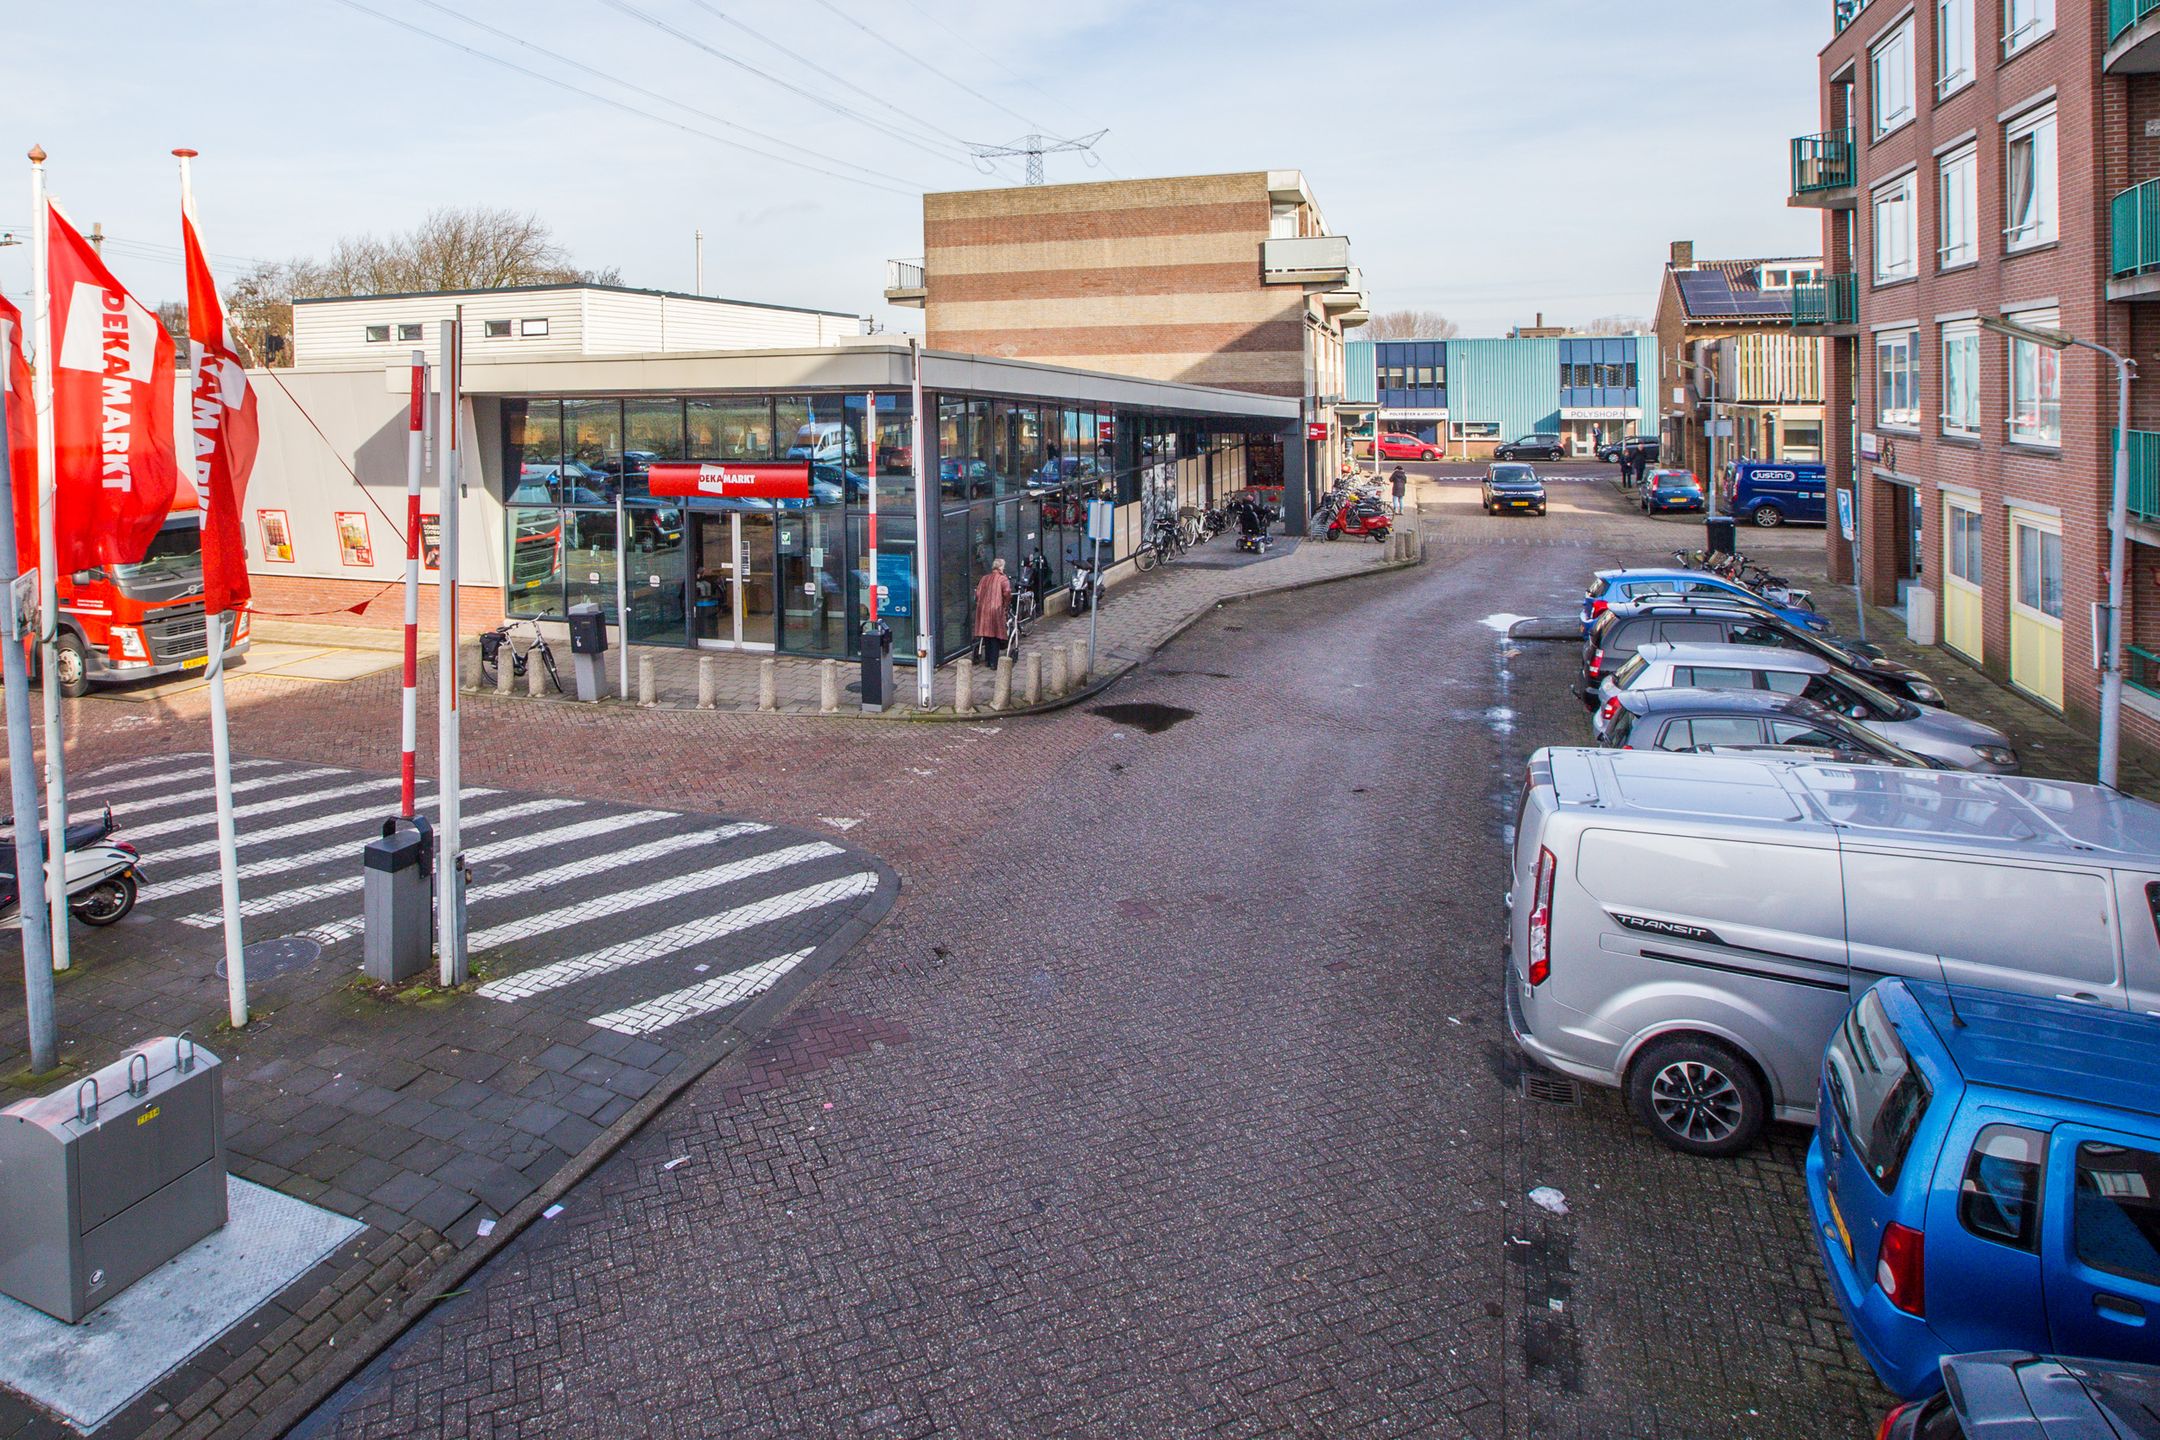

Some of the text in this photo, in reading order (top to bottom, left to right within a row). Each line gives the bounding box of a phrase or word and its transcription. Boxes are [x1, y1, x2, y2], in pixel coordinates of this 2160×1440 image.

[102, 289, 132, 493] DEKAMARKT
[700, 474, 755, 484] DEKAMARKT
[1617, 914, 1707, 936] TRANSIT
